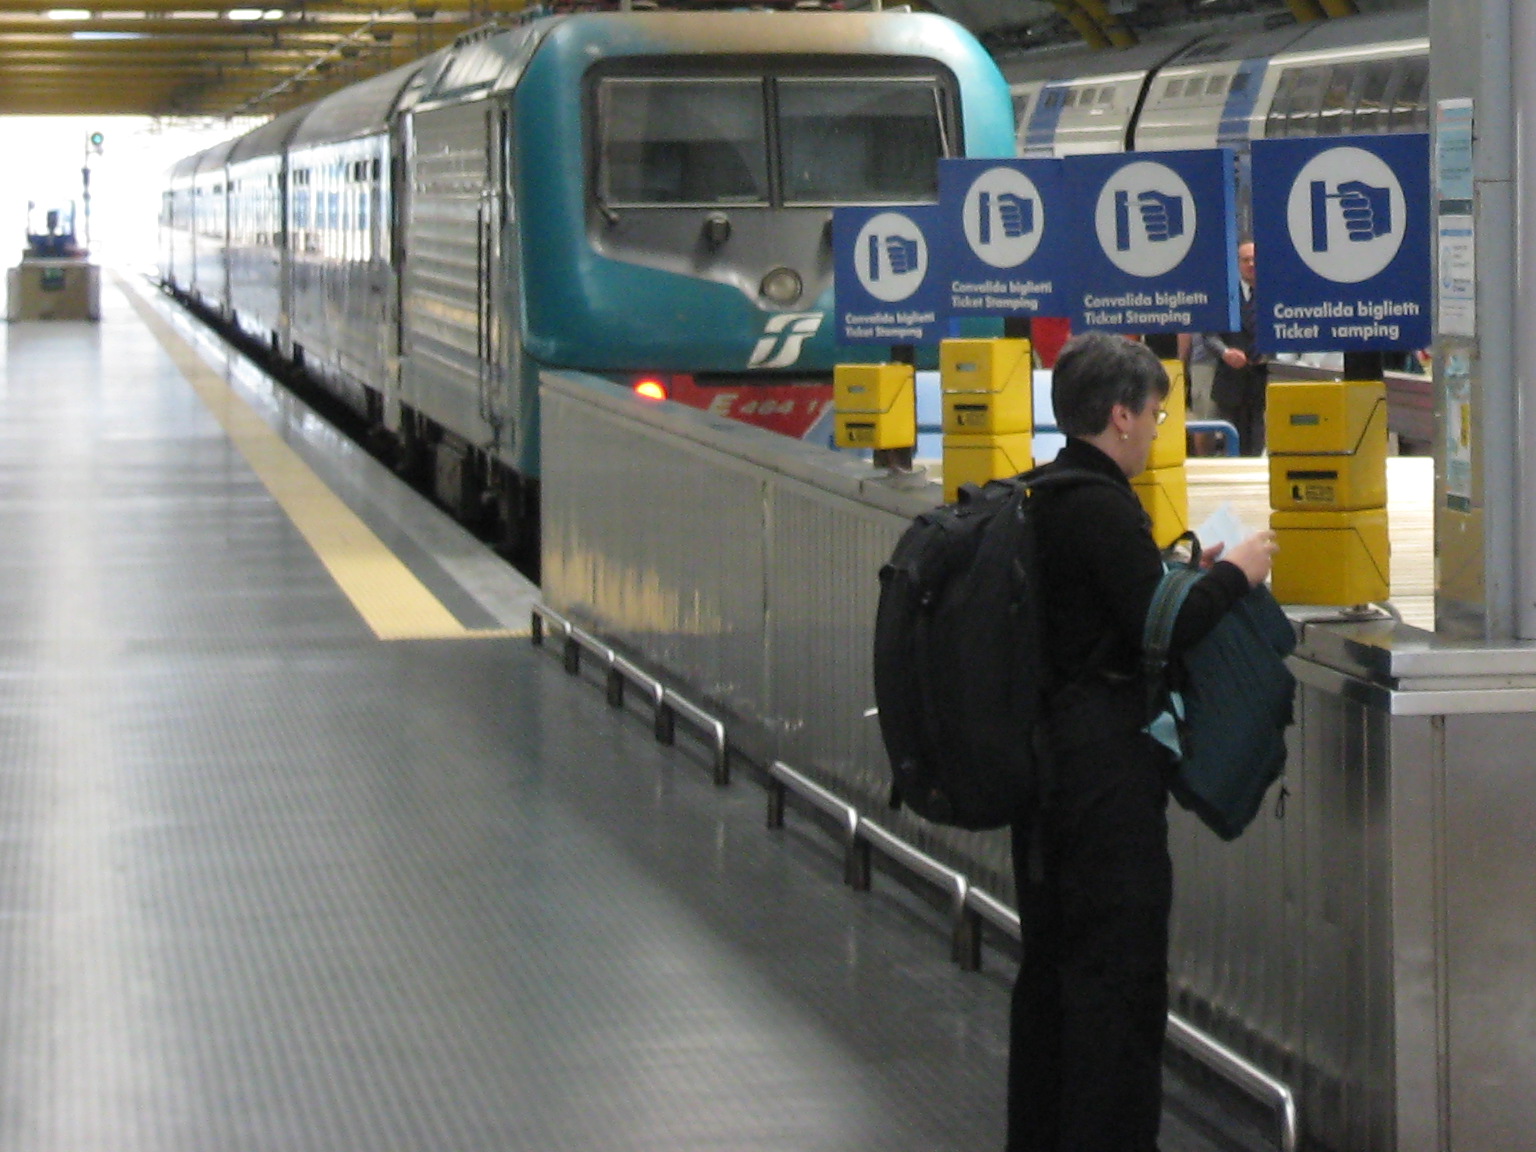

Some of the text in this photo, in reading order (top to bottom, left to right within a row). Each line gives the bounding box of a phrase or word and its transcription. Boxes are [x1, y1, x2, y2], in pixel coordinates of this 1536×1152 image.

[952, 281, 1052, 295] Convalida biglietti
[952, 296, 1038, 310] Ticket Stamping
[1084, 292, 1208, 308] Convalida biglietti
[1084, 309, 1192, 326] Ticket Stamping
[1274, 301, 1419, 319] Convalida biglietti
[845, 312, 895, 325] Convalida
[1274, 323, 1319, 339] Ticket
